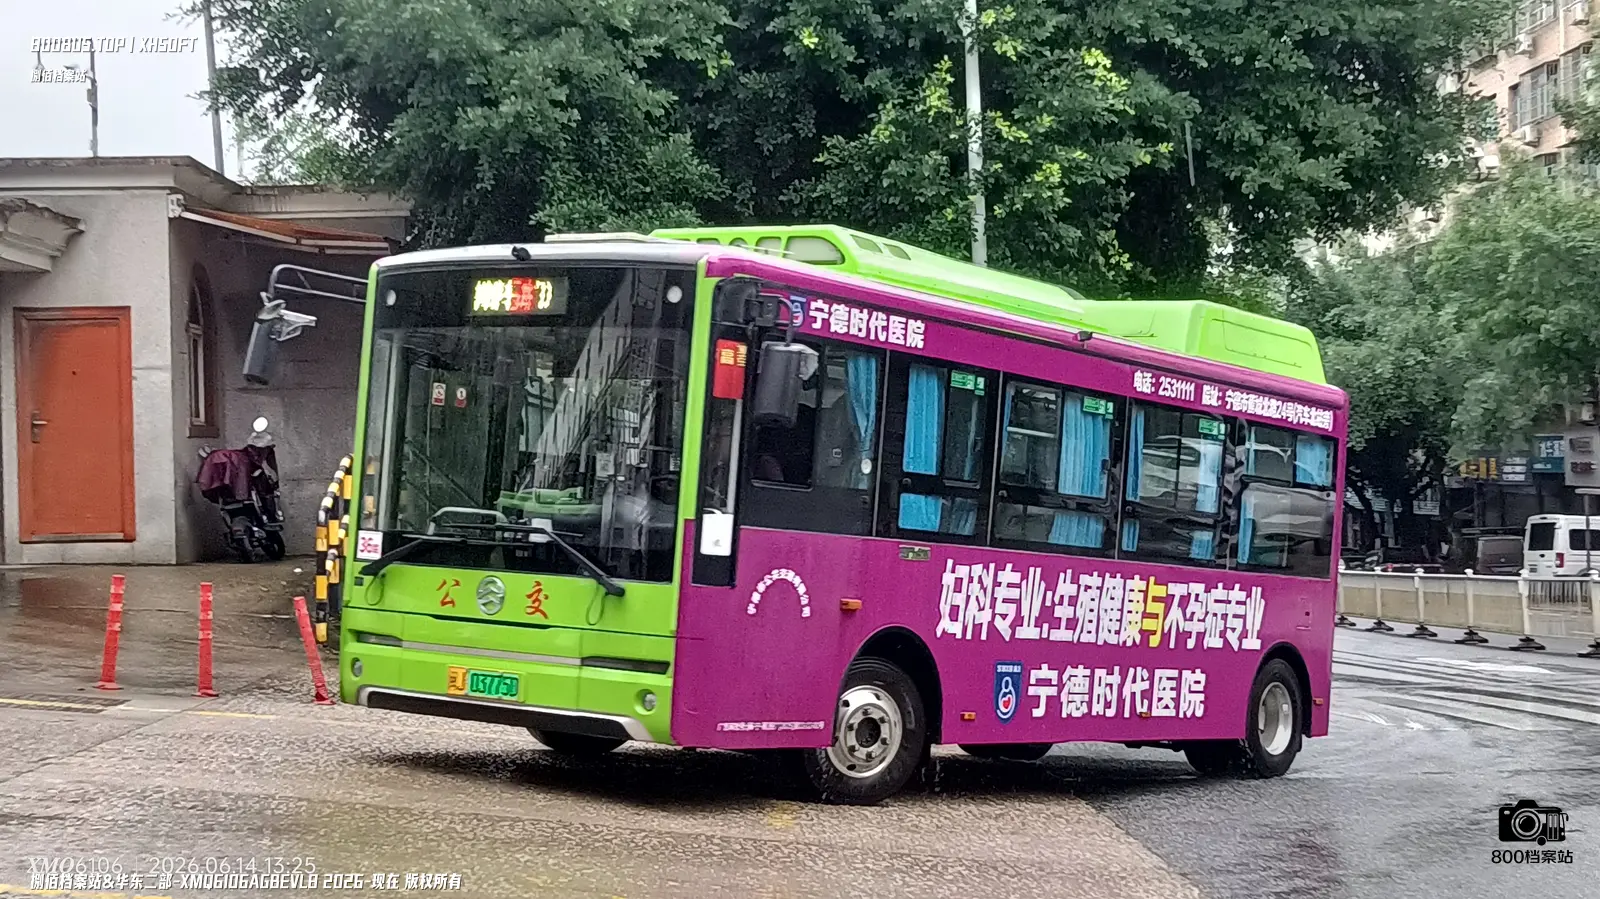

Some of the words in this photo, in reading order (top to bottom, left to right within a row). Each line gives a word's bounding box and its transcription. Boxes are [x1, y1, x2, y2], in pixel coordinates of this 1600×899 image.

[808, 299, 926, 349] 宁德时代医院
[1158, 376, 1196, 402] 2531111
[1027, 663, 1207, 718] 宁德时代医院
